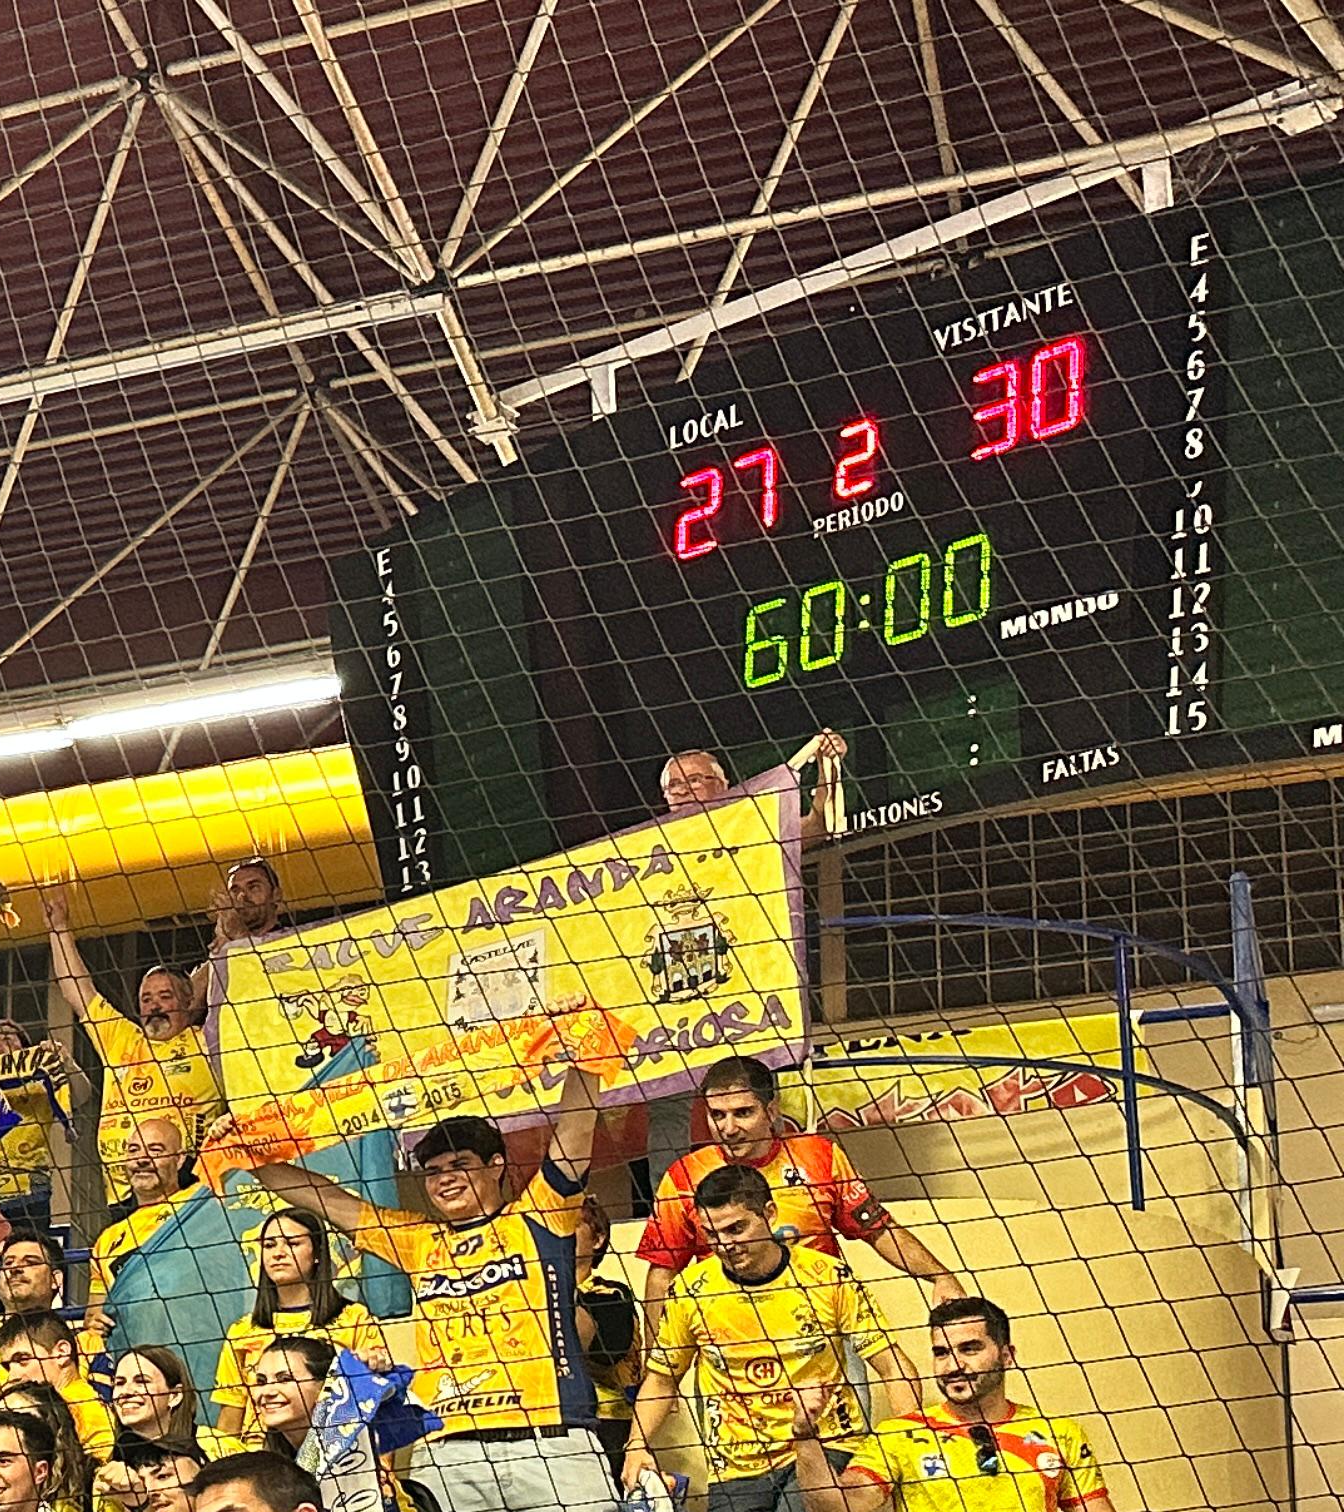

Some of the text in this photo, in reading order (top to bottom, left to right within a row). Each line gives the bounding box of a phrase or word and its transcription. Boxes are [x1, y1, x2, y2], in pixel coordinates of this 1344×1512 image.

[1190, 233, 1209, 266] E
[1190, 273, 1209, 303] 4
[934, 283, 1074, 350] VISITANTE
[1188, 311, 1207, 342] 5
[1187, 350, 1205, 381] 6
[970, 334, 1085, 461] 30
[1185, 387, 1205, 421] 7
[669, 405, 743, 449] LOCAL
[1184, 428, 1204, 459] 8
[834, 418, 879, 499] 2
[675, 440, 778, 561] 27
[814, 492, 905, 539] PERIODO
[1171, 504, 1212, 540] 10
[1170, 542, 1211, 580] 11
[745, 534, 990, 688] 60:00
[1000, 590, 1120, 640] MONDO
[1168, 582, 1211, 619] 12
[383, 611, 398, 637] 5
[1167, 622, 1210, 657] 13
[387, 646, 400, 668] 6
[391, 672, 402, 700] 7
[1166, 661, 1209, 697] 14
[393, 704, 407, 731] 8
[1164, 701, 1207, 736] 15
[395, 737, 409, 762] 9
[1042, 744, 1120, 783] FALTAS
[392, 765, 421, 796] 10
[395, 796, 424, 830] 11
[398, 828, 426, 861] 12
[401, 861, 431, 892] 13
[421, 1082, 463, 1109] 2015
[341, 1110, 381, 1134] 2014
